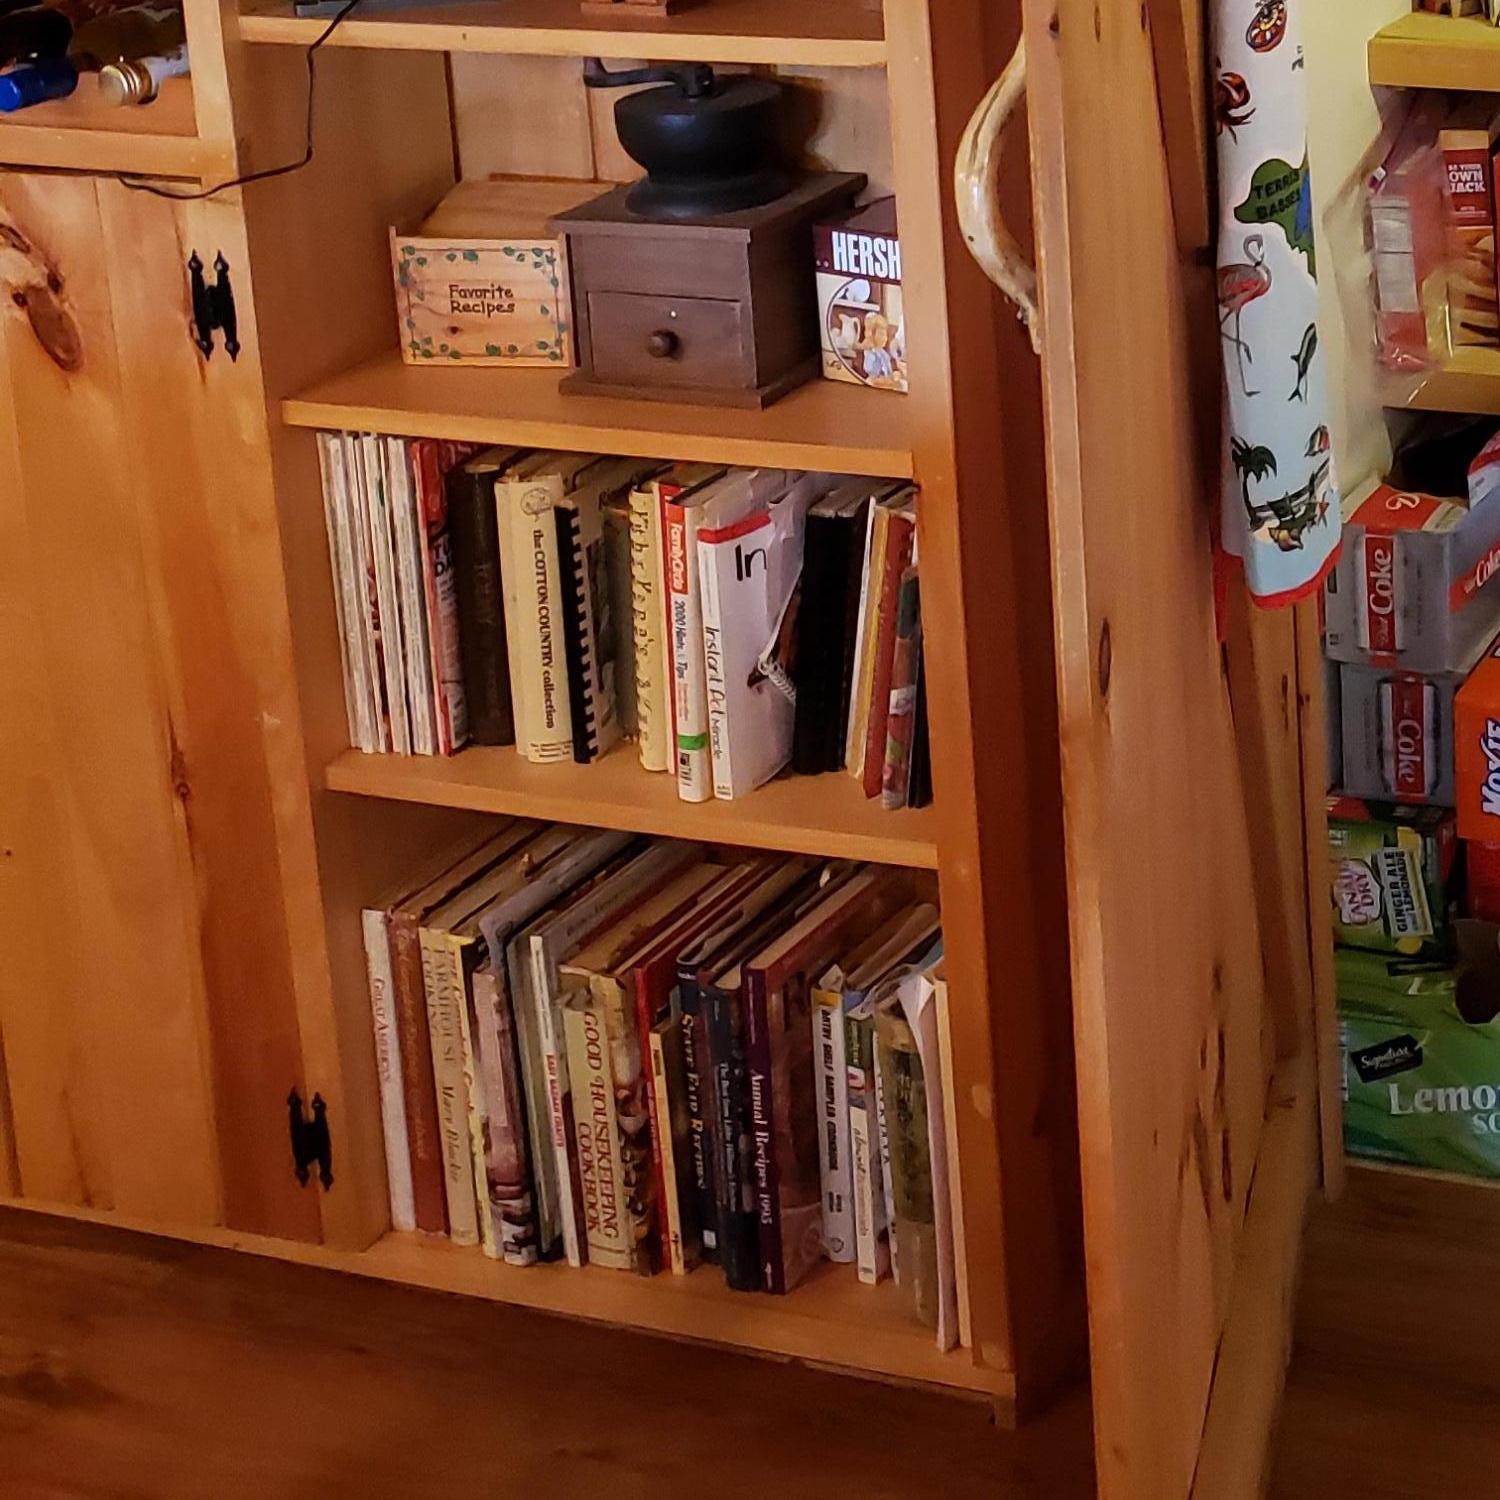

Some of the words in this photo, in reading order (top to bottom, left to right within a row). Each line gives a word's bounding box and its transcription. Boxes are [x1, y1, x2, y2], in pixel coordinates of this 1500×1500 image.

[1449, 170, 1484, 182] OWN
[1449, 181, 1486, 193] JACK
[448, 283, 515, 301] Favorite
[450, 298, 516, 318] Recipes
[1369, 547, 1394, 616] Coke
[532, 529, 545, 548] the
[542, 669, 555, 729] collection
[1397, 718, 1422, 785] Coke
[1356, 874, 1375, 908] DRY
[1384, 851, 1398, 879] ALE
[1390, 883, 1409, 933] GINGER
[583, 1011, 603, 1071] GOOD
[750, 1072, 769, 1127] Annual
[578, 1121, 601, 1232] COOKBOOK
[589, 1074, 620, 1240] HOUSEKEEPING
[754, 1130, 775, 1189] Recipes
